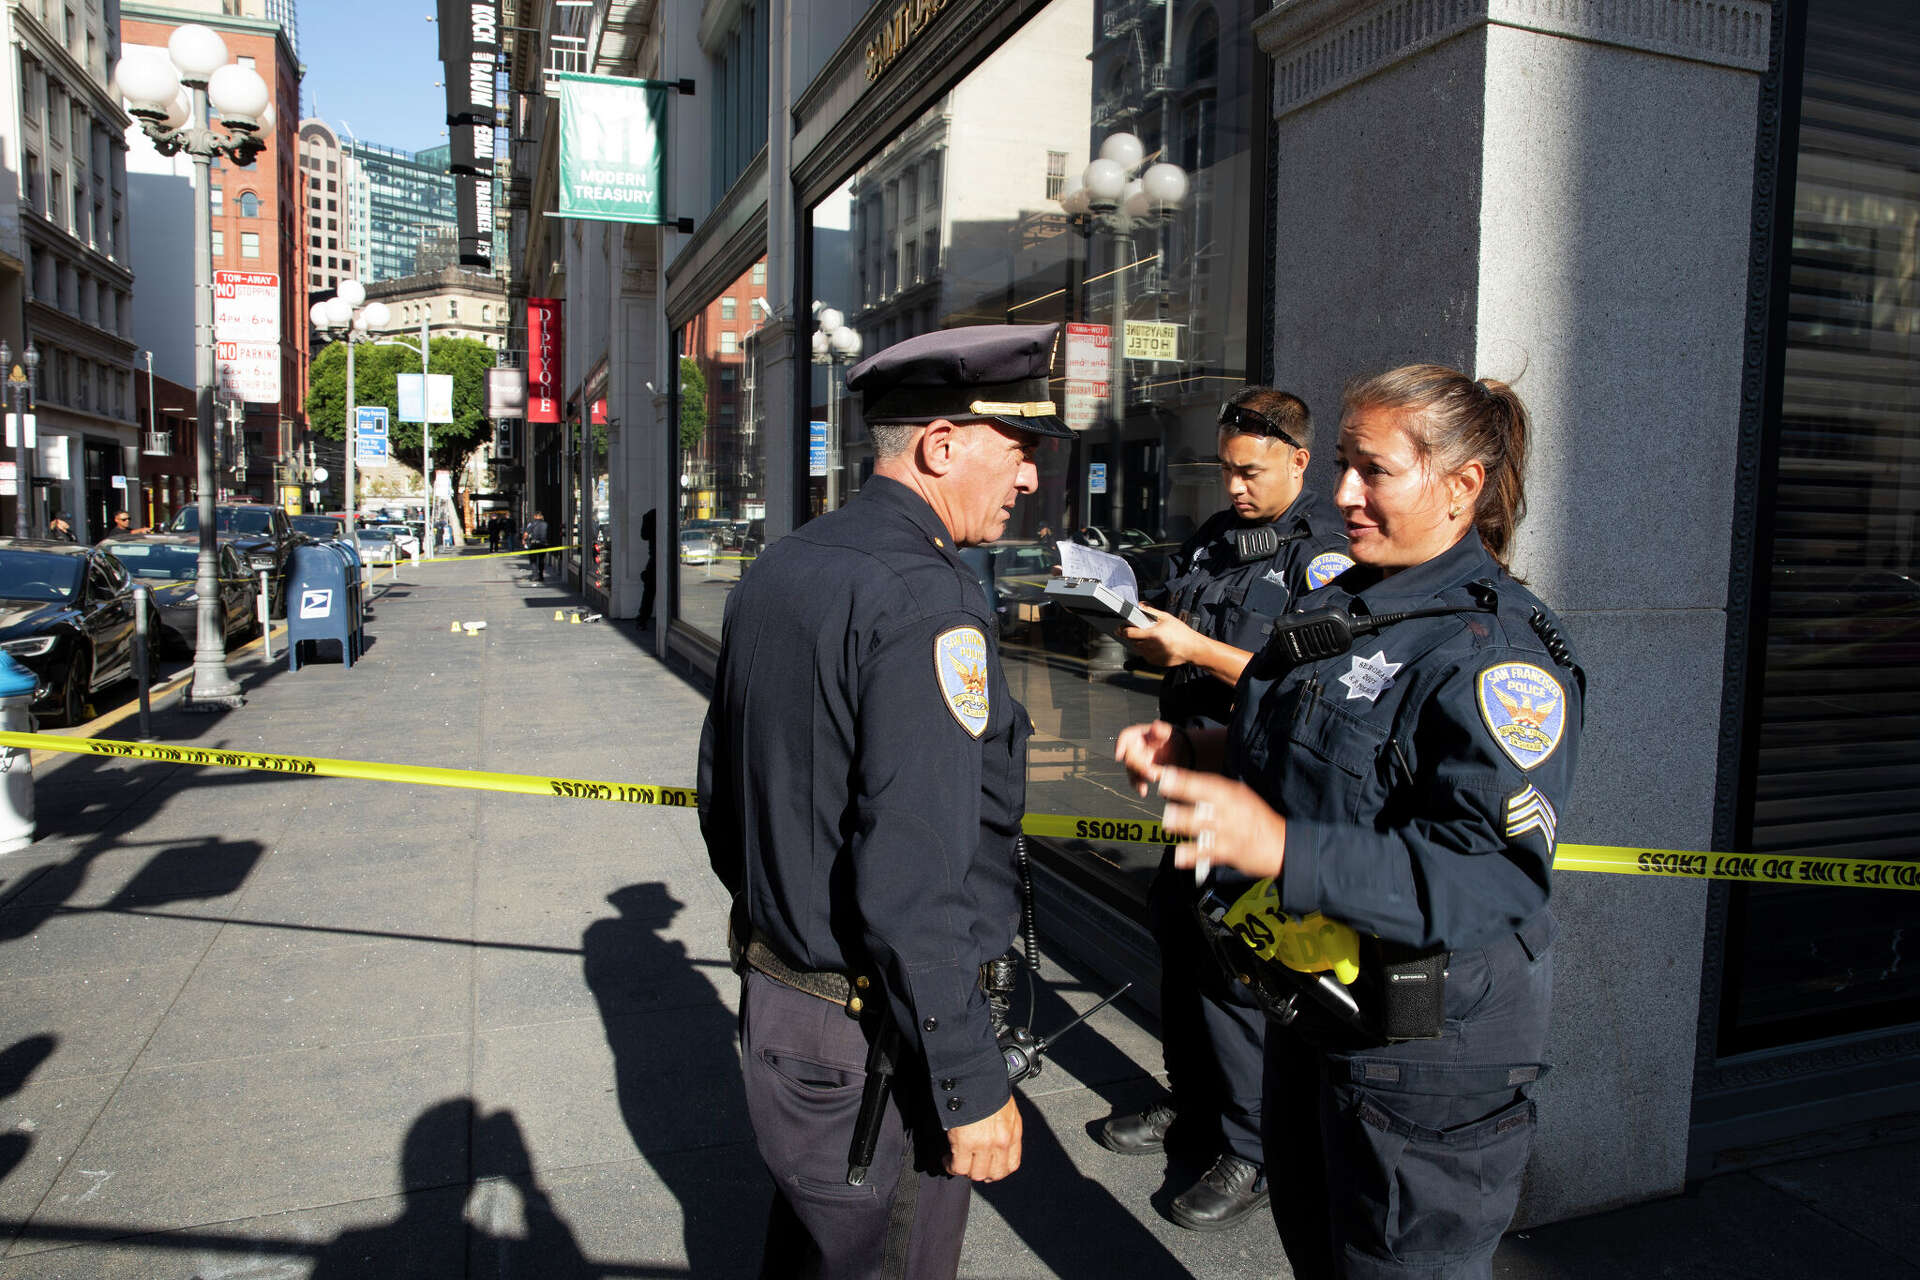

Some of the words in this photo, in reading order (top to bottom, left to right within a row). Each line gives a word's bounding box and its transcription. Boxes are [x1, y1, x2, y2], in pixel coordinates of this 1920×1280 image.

[471, 4, 496, 44] KOCH
[580, 169, 646, 187] MODERN
[574, 185, 654, 203] TREASURY
[475, 180, 492, 233] FRAENKEL
[222, 273, 272, 285] TOW-AWAY
[217, 283, 235, 297] NO
[238, 287, 277, 298] STOPPING
[219, 343, 237, 360] NO
[240, 347, 278, 360] PARKING
[539, 308, 552, 413] DIPTYQUE
[490, 383, 521, 393] Theory
[944, 634, 962, 650] SAN
[1487, 669, 1510, 685] SAN
[1511, 668, 1561, 698] FRANCISCO
[1507, 681, 1546, 698] POLICE
[550, 780, 612, 800] CROSS
[618, 786, 655, 805] NOT
[660, 790, 687, 807] DO
[1076, 820, 1143, 842] CROSS
[1637, 852, 1708, 876] CROSS
[1712, 856, 1758, 878] NOT
[1762, 859, 1793, 880] DO
[1800, 860, 1849, 882] LINE
